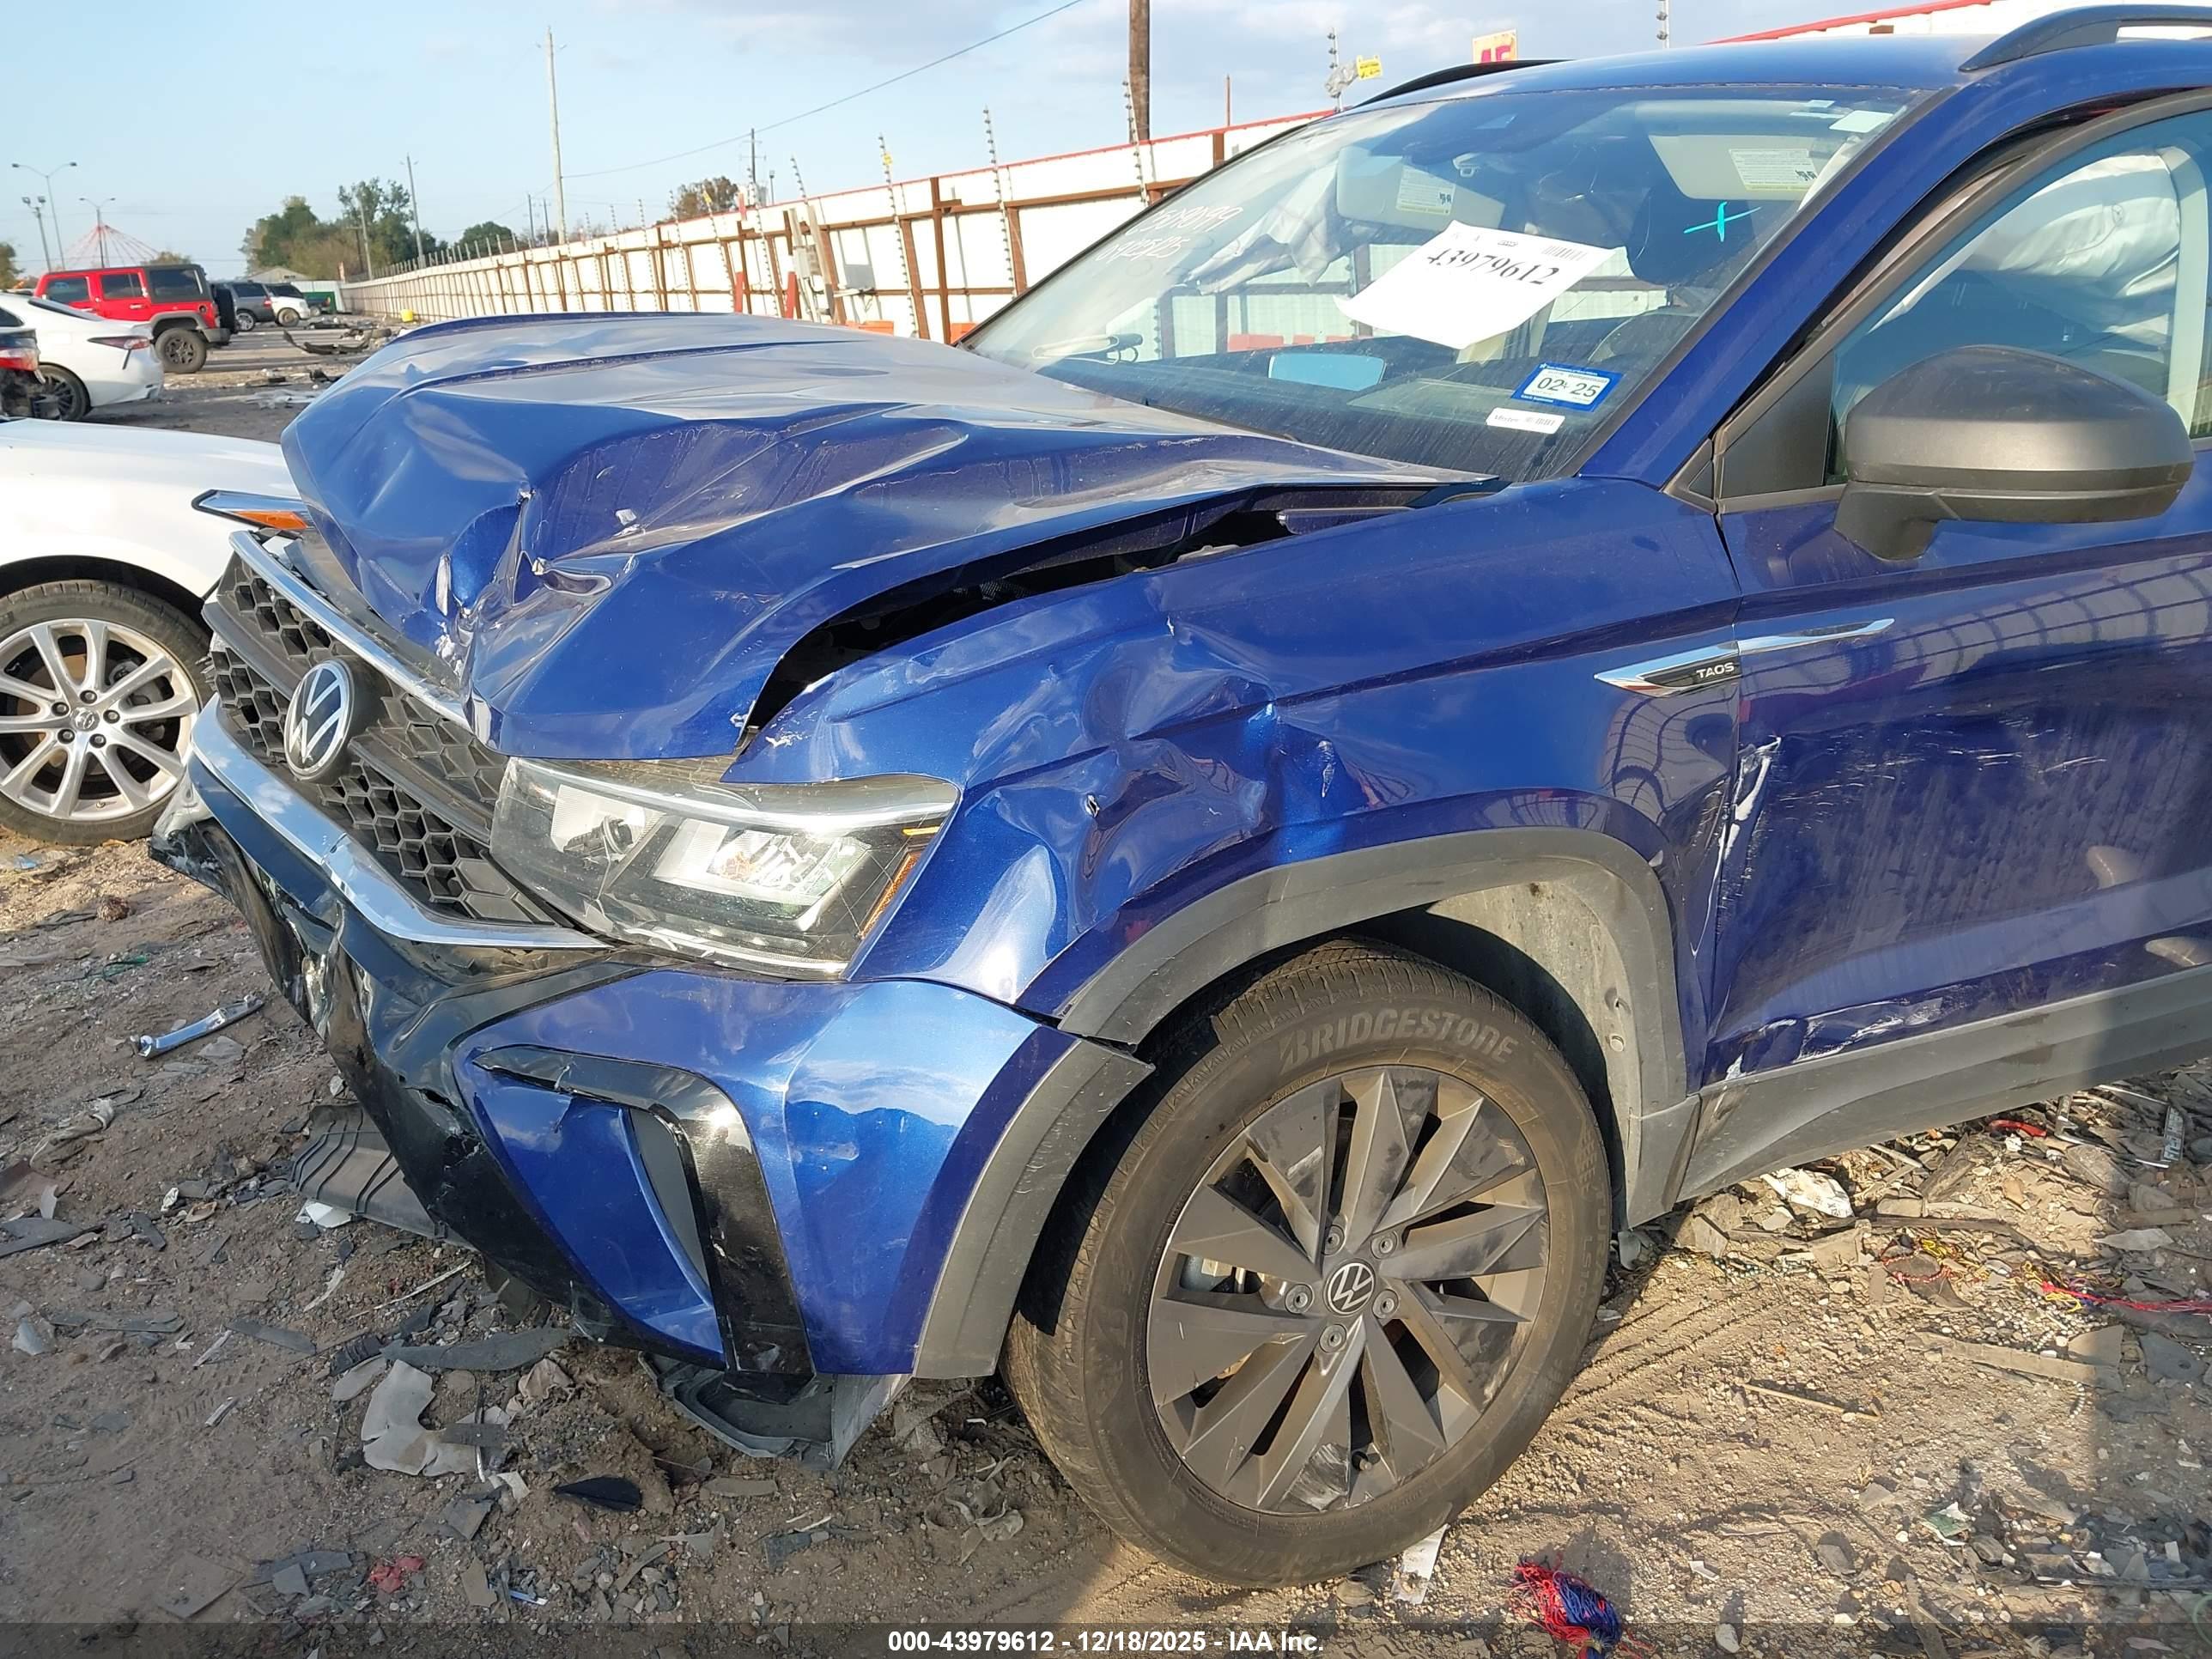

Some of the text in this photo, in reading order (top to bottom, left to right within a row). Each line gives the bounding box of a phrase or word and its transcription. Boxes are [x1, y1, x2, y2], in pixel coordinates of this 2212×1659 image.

[1426, 248, 1559, 285] 43979612
[1537, 377, 1565, 392] 02
[1570, 382, 1601, 398] 25
[1697, 662, 1735, 678] TAOS
[1279, 1007, 1519, 1074] BRIDGESTONE
